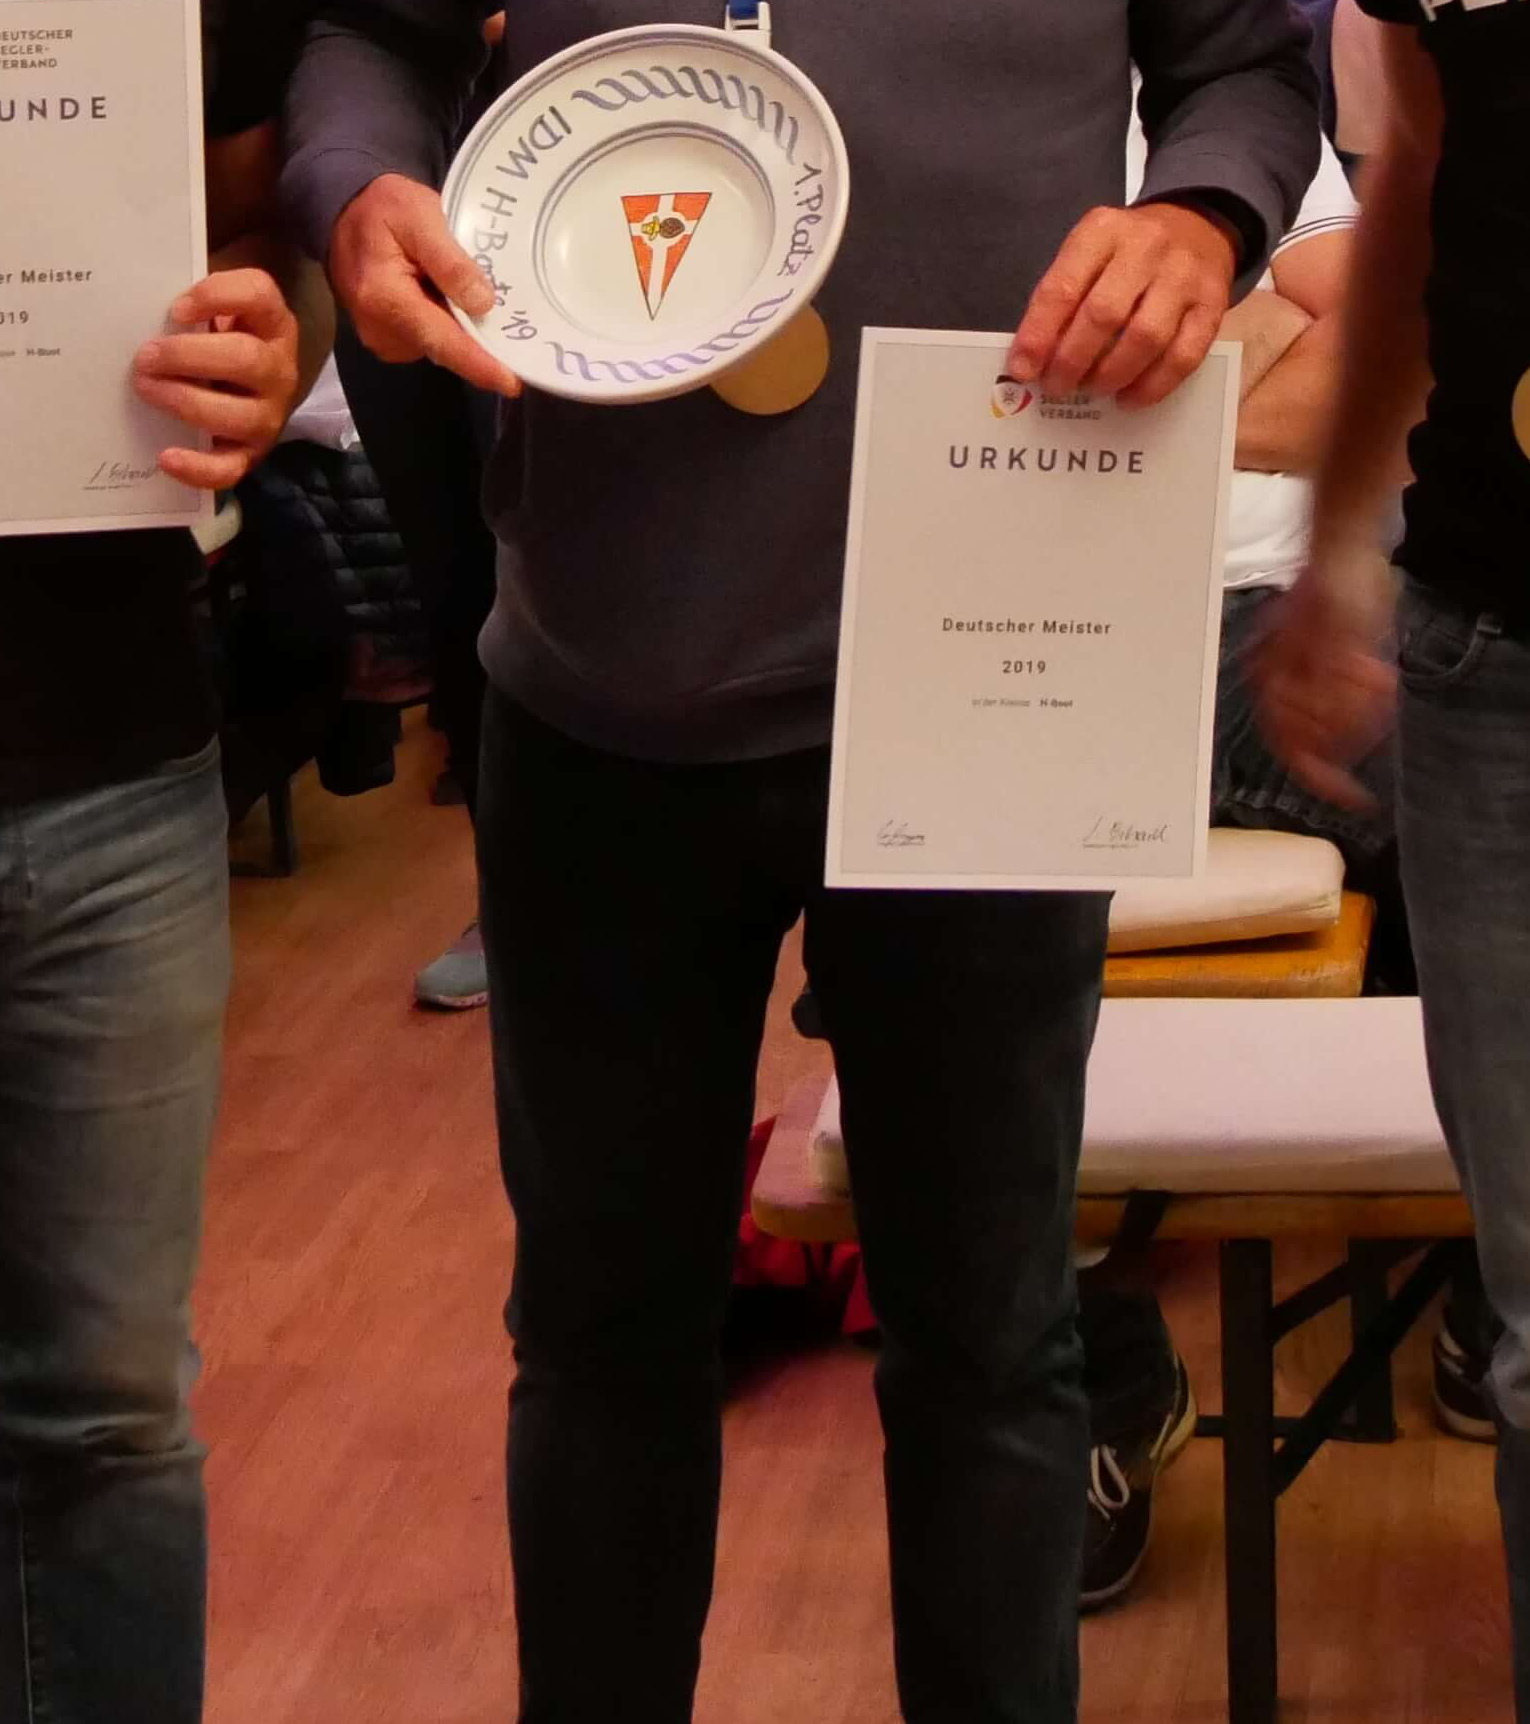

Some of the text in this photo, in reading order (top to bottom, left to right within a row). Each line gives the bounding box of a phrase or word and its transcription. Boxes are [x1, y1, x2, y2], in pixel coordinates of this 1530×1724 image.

[494, 103, 574, 182] IDM
[20, 267, 94, 286] Meister
[1038, 408, 1102, 422] VERBAND
[949, 445, 1147, 475] URKUNDE
[942, 617, 1113, 635] Deutscher Meister
[1001, 659, 1048, 675] 2019
